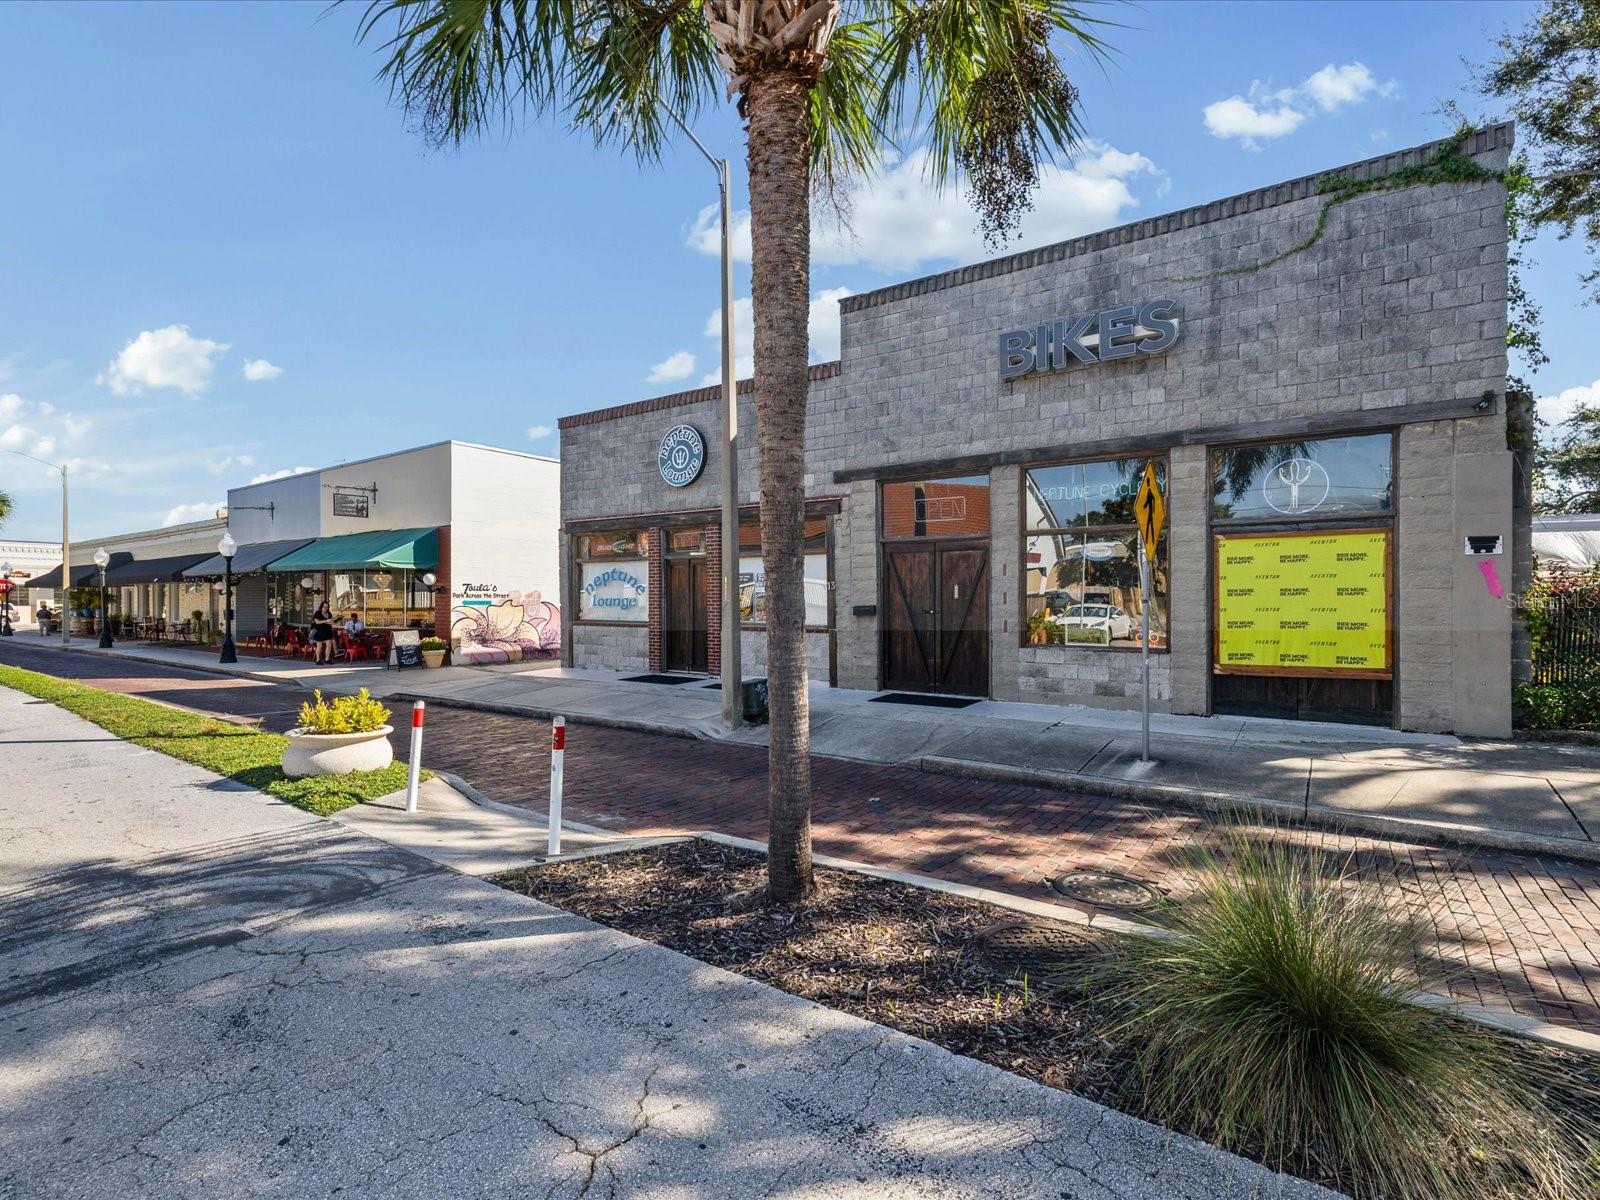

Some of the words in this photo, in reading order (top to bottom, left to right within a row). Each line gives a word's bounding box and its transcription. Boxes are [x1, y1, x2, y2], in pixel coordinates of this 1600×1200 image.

[999, 297, 1179, 379] BIKES
[1099, 478, 1167, 497] CYCLY
[917, 499, 964, 520] OPEN
[462, 584, 498, 594] Toula's
[585, 568, 646, 595] neptune
